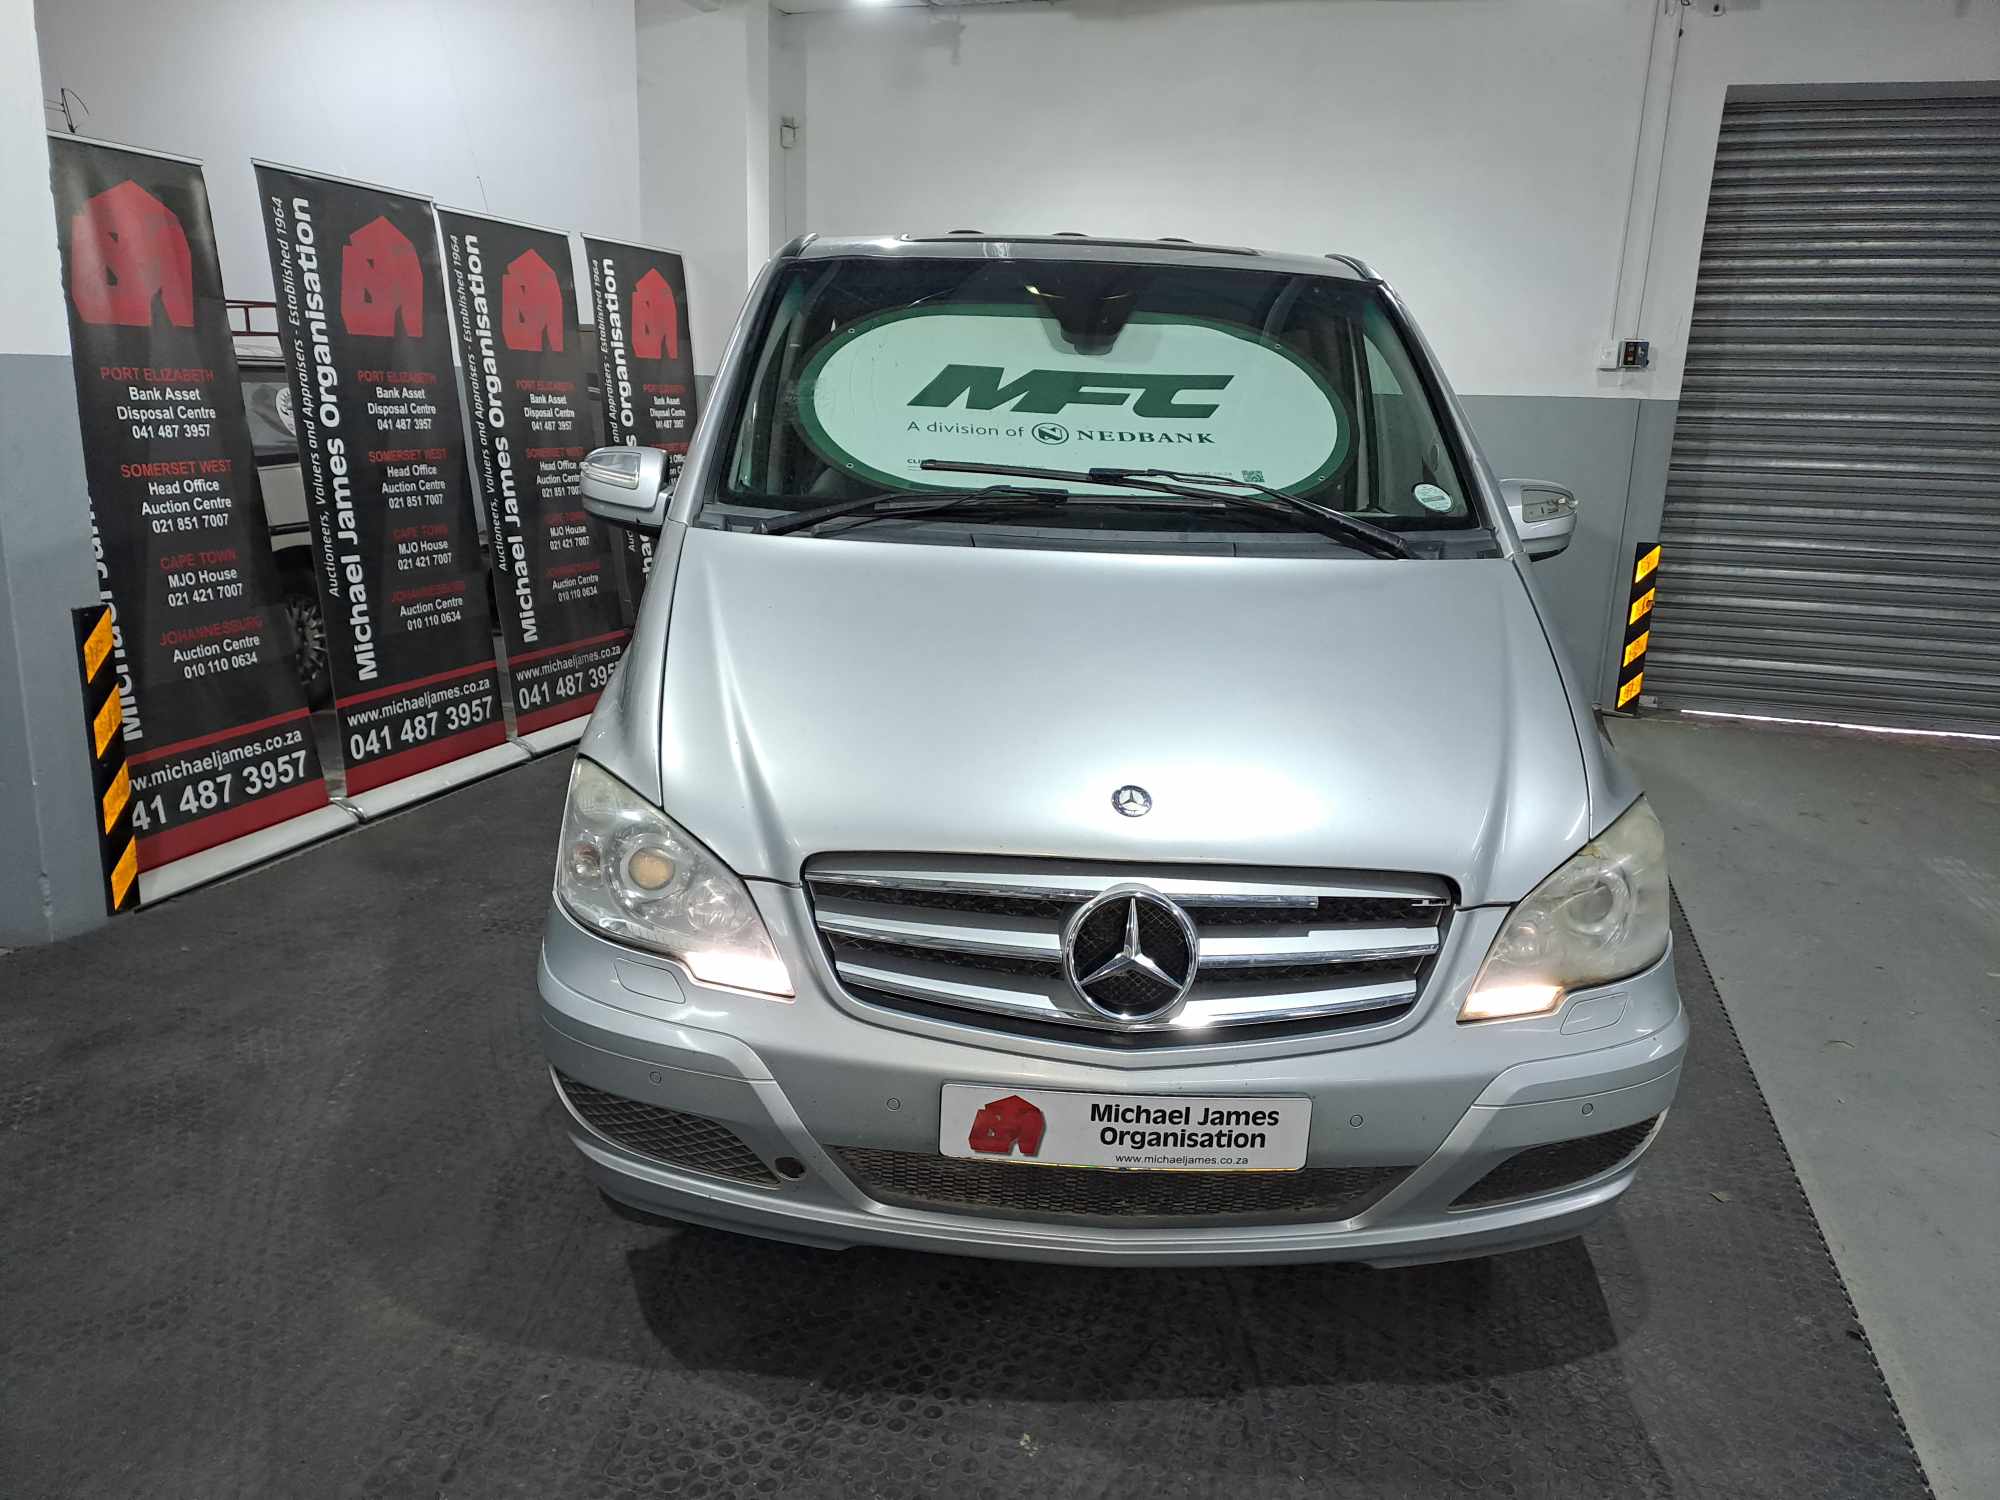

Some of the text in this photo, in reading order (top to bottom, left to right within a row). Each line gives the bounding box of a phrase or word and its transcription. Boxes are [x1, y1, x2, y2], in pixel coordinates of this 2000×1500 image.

[272, 196, 287, 237] 1964
[450, 234, 461, 266] 1964
[276, 238, 301, 326] Established
[455, 268, 473, 343] Established
[603, 258, 634, 428] Organisation
[101, 367, 214, 382] PORT ELIZABETH
[295, 340, 313, 417] Appraisers
[129, 386, 200, 401] Bank Asset
[376, 386, 426, 399] Bank Asset
[468, 353, 484, 420] Appraisers
[906, 364, 1235, 418] MFC
[367, 402, 437, 417] Disposal Centre
[530, 394, 567, 404] Bank Asset
[117, 406, 216, 422] Disposal Centre
[377, 418, 432, 431] 041 487 3957
[524, 407, 553, 419] Disposal
[132, 424, 210, 439] 041 487 3957
[292, 197, 378, 681] Michael James Organisation
[303, 418, 317, 451] and
[465, 235, 538, 643] Michael James Organisation
[475, 421, 487, 446] and
[907, 420, 1216, 444] A division of NEDBANK
[120, 460, 232, 478] SOMERSET WEST
[387, 464, 437, 478] Head Office
[480, 449, 495, 494] Valuers
[557, 460, 577, 470] Office
[148, 479, 219, 495] Head Office
[312, 452, 327, 505] Valuers
[381, 478, 446, 494] Auction Centre
[536, 475, 560, 485] Auction
[141, 497, 232, 515] Auction Centre
[389, 493, 443, 509] 021 851 7007
[152, 513, 229, 533] 021 851 7007
[491, 498, 508, 571] Auctioneers,
[550, 526, 587, 537] MJO House
[319, 510, 340, 597] Auctioneers,
[398, 540, 448, 555] MJO House
[398, 553, 452, 571] 021 421 7007
[168, 568, 237, 588] MJO House
[552, 574, 599, 590] Auction Centre
[168, 583, 243, 607] 021 421 7007
[400, 596, 463, 617] Auction Centre
[407, 610, 461, 631] 010 110 0634
[173, 635, 260, 663] Auction Centre
[184, 652, 258, 679] 010 110 0634
[516, 645, 621, 681] www.michaeljames.co.za
[518, 681, 550, 709] 041
[556, 672, 583, 697] 487
[347, 678, 490, 727] www.michaeljames.co.za
[350, 695, 493, 760] 041 487 3957
[179, 773, 232, 814] 487
[242, 750, 307, 795] 3957
[1090, 1103, 1279, 1127] Michael James
[1100, 1127, 1266, 1150] Organisation
[1115, 1154, 1249, 1166] www.michaeljames.co.za
